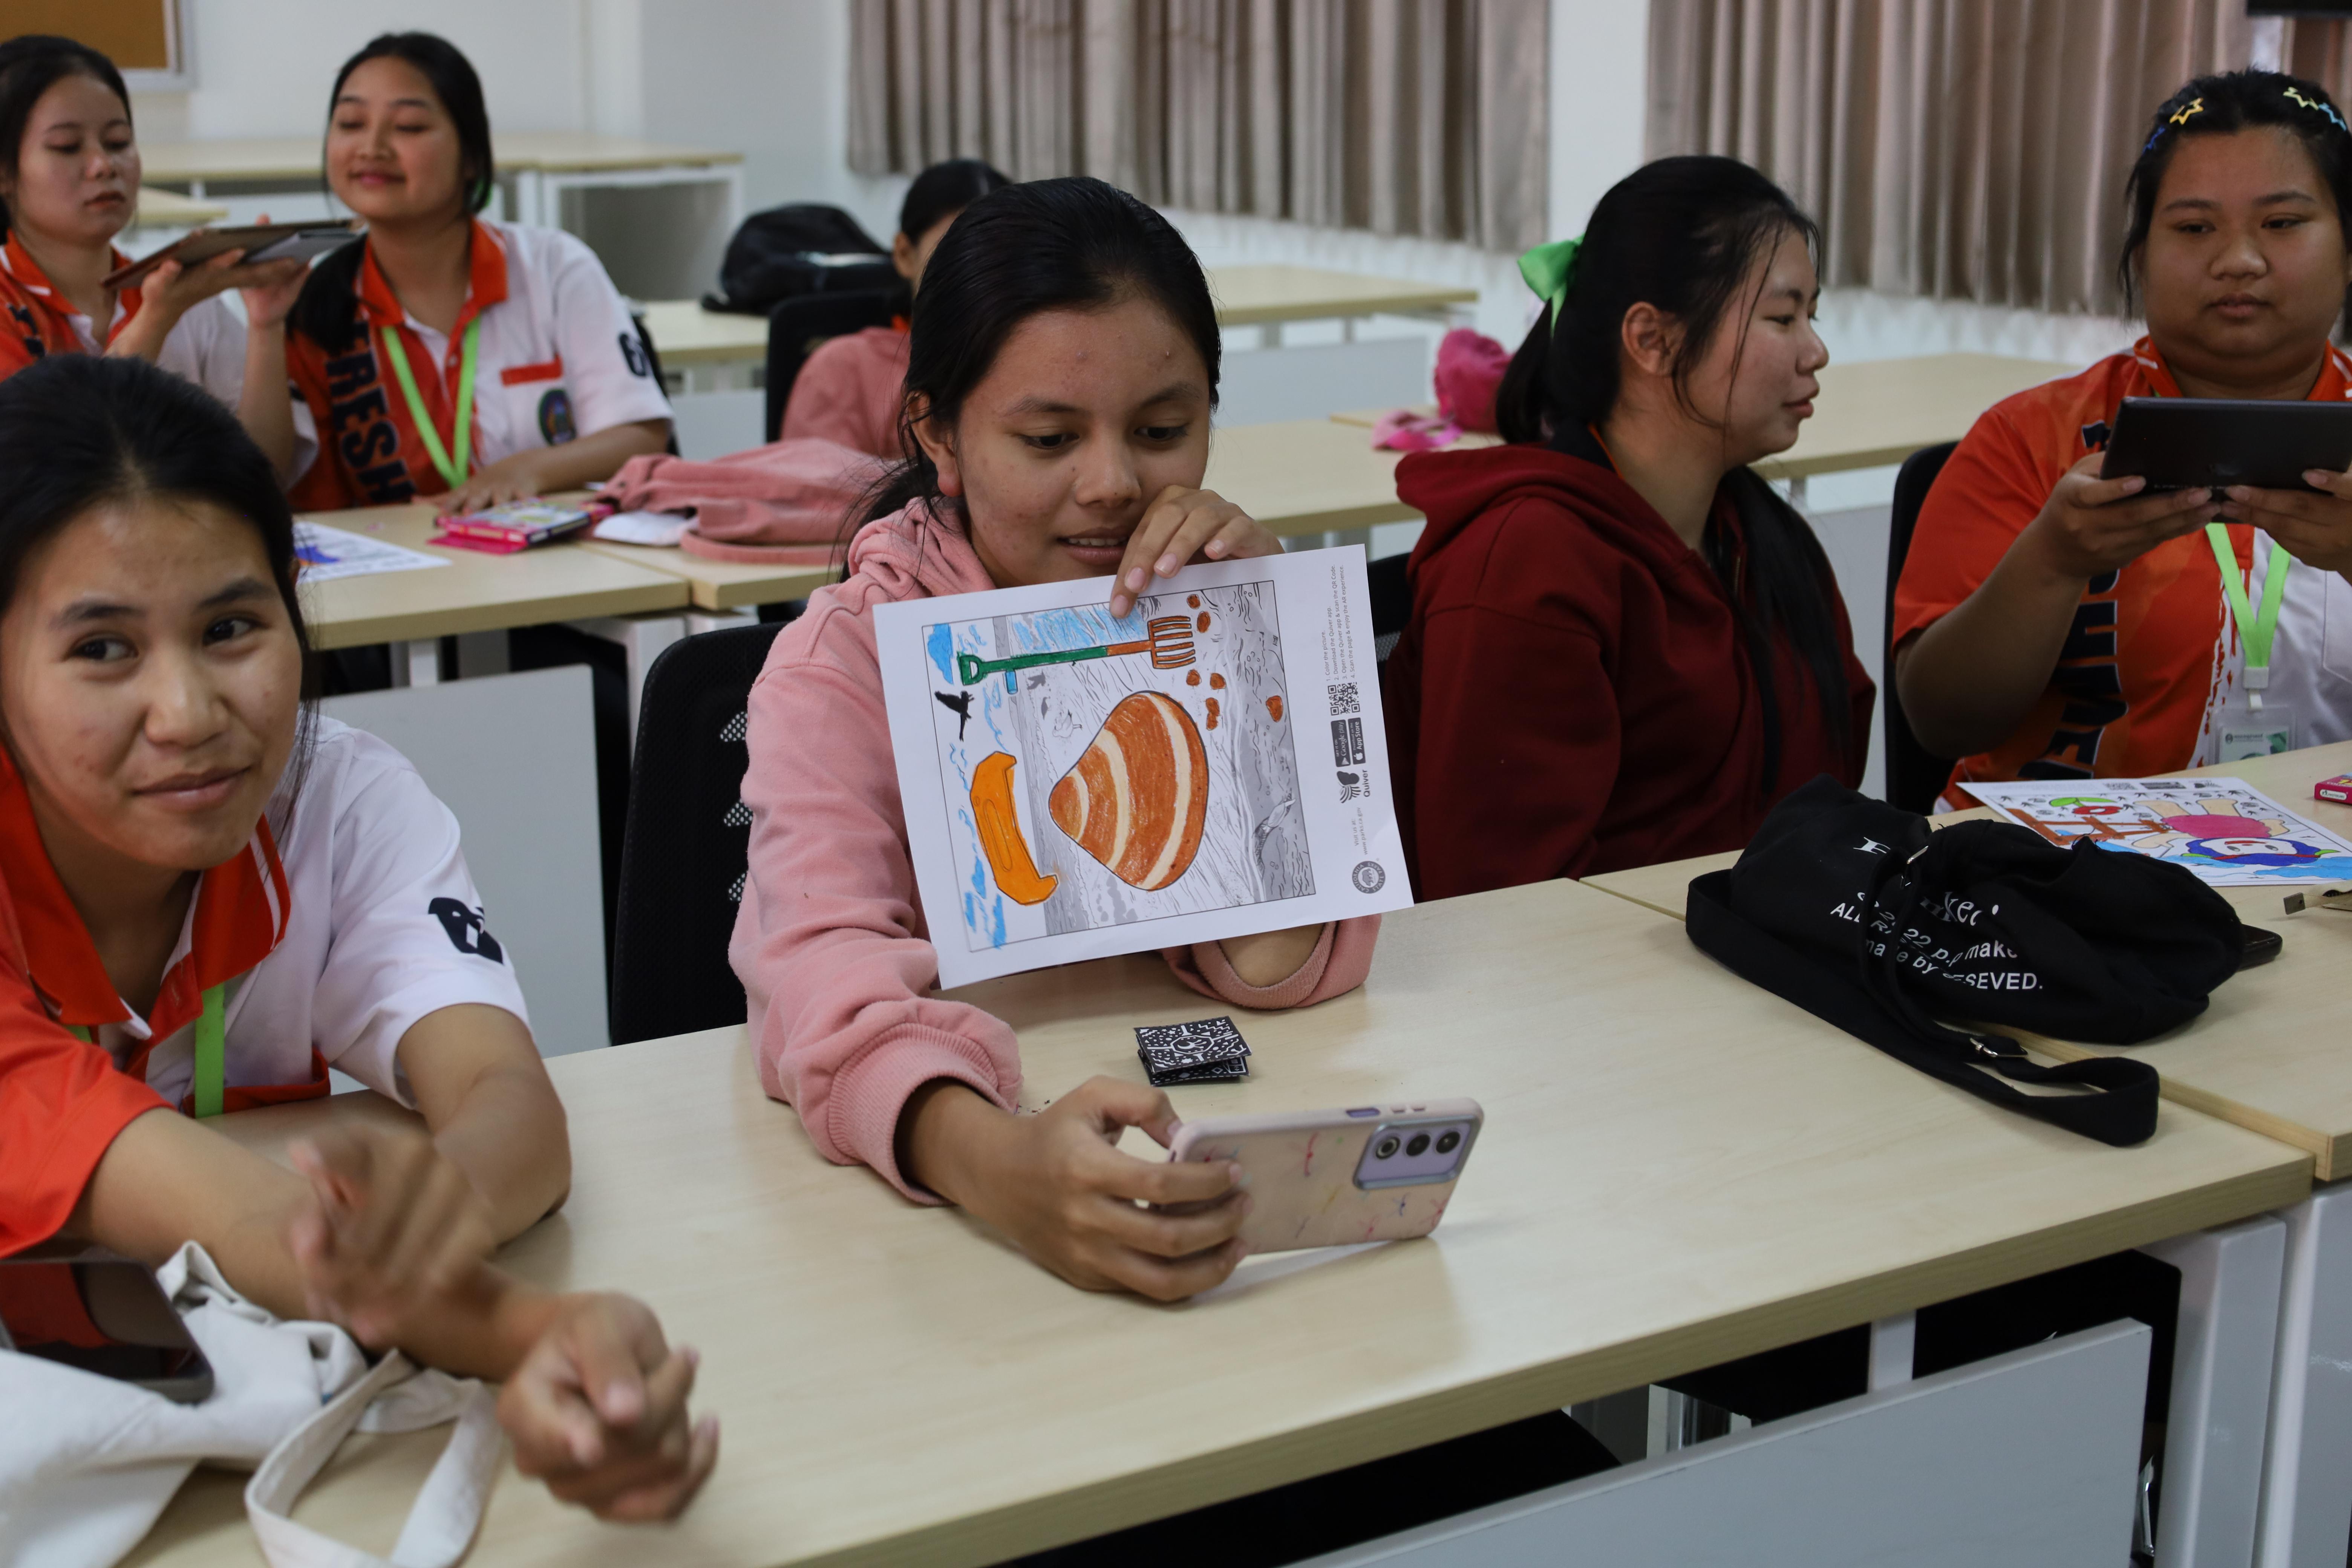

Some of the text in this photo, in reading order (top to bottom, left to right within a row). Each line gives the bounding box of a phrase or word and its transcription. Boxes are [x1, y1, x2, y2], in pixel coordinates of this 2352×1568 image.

[1331, 580, 1338, 589] QR
[1338, 734, 1347, 756] Google
[1362, 769, 1370, 797] Quiver
[1357, 807, 1367, 855] www.parks.ca.gov
[1353, 864, 1369, 892] CALIFORNIA
[1367, 862, 1384, 891] STATE PARKS
